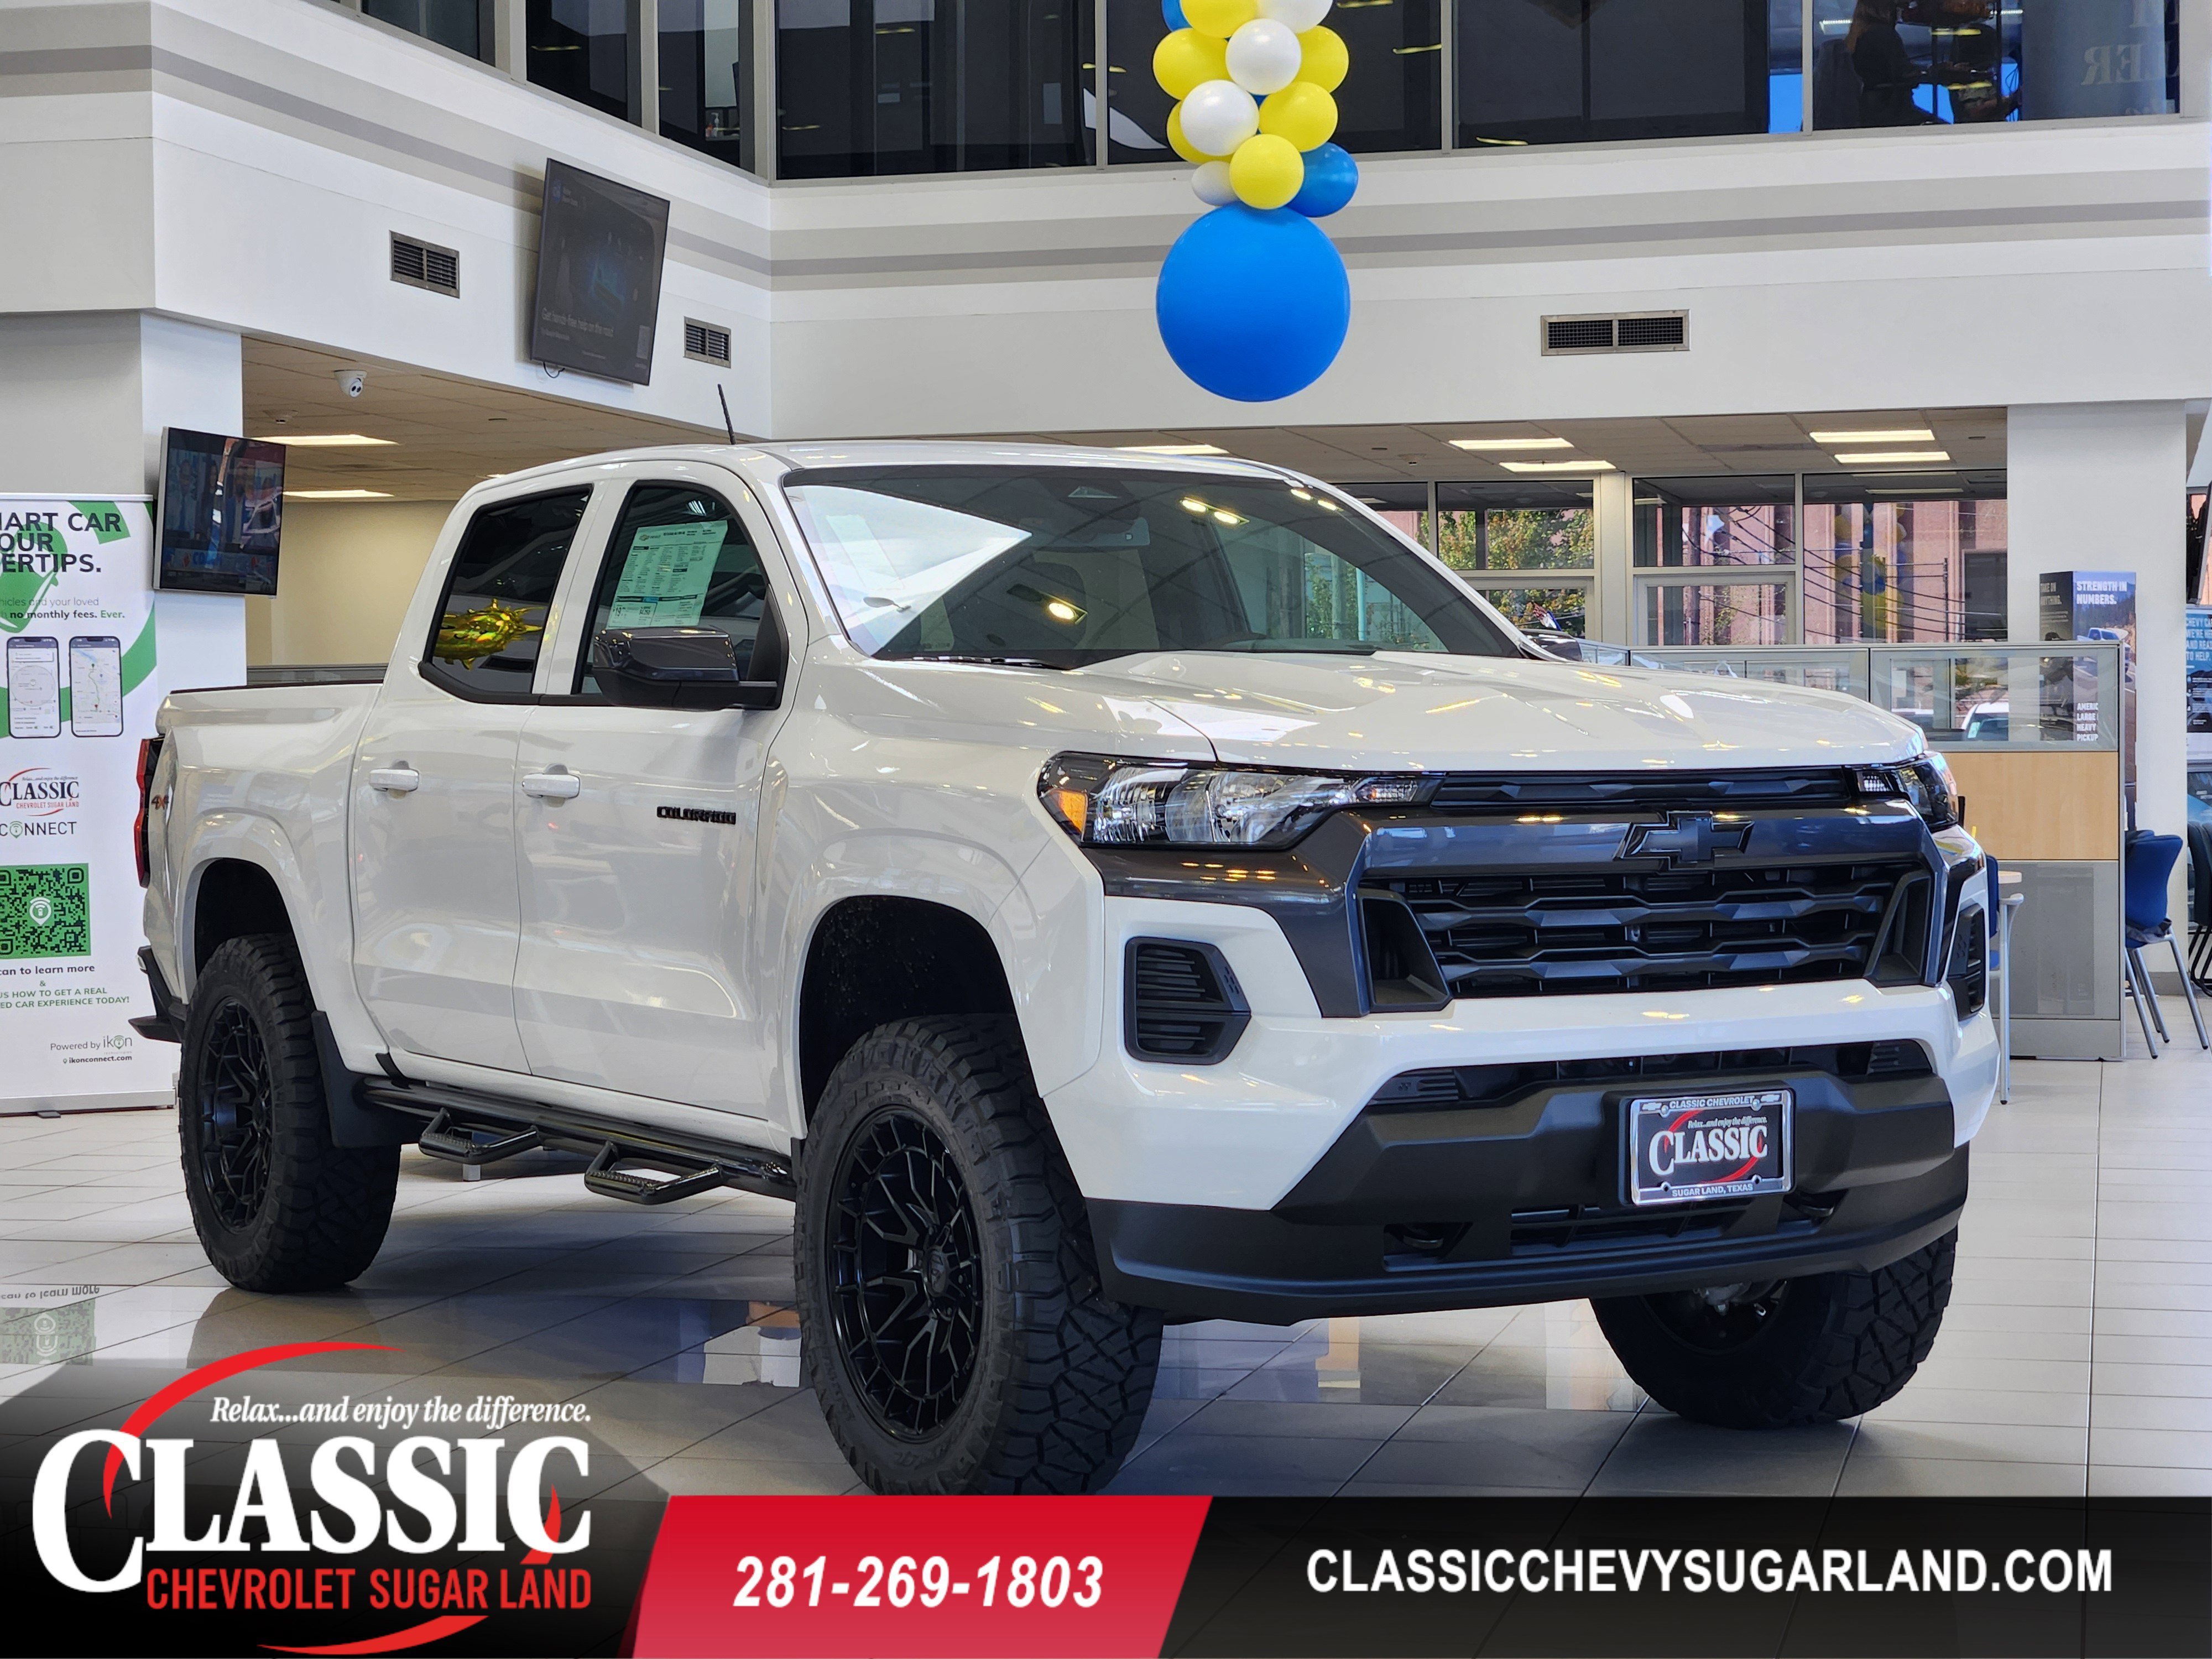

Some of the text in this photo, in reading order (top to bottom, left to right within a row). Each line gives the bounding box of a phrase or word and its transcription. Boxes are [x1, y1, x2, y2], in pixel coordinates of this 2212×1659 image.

[0, 513, 122, 532] ART CAR
[2077, 581, 2127, 592] STRENGTH IN
[29, 598, 47, 606] and
[50, 599, 71, 607] your
[74, 597, 99, 606] loved
[2077, 594, 2117, 605] NUMBERS.
[28, 610, 70, 620] monthly
[73, 610, 97, 619] fees.
[2077, 723, 2096, 732] HEAVY
[0, 781, 79, 806] CLASSIC
[35, 966, 64, 974] learn
[67, 965, 95, 973] more
[38, 998, 93, 1007] EXPERIENCE
[50, 1041, 88, 1051] Powered
[90, 1041, 101, 1050] by
[1670, 1095, 1755, 1109] CLASSIC CHEVROLET
[1649, 1125, 1768, 1176] CLASSIC
[1672, 1183, 1753, 1197] SUGAR LAND, TEXAS
